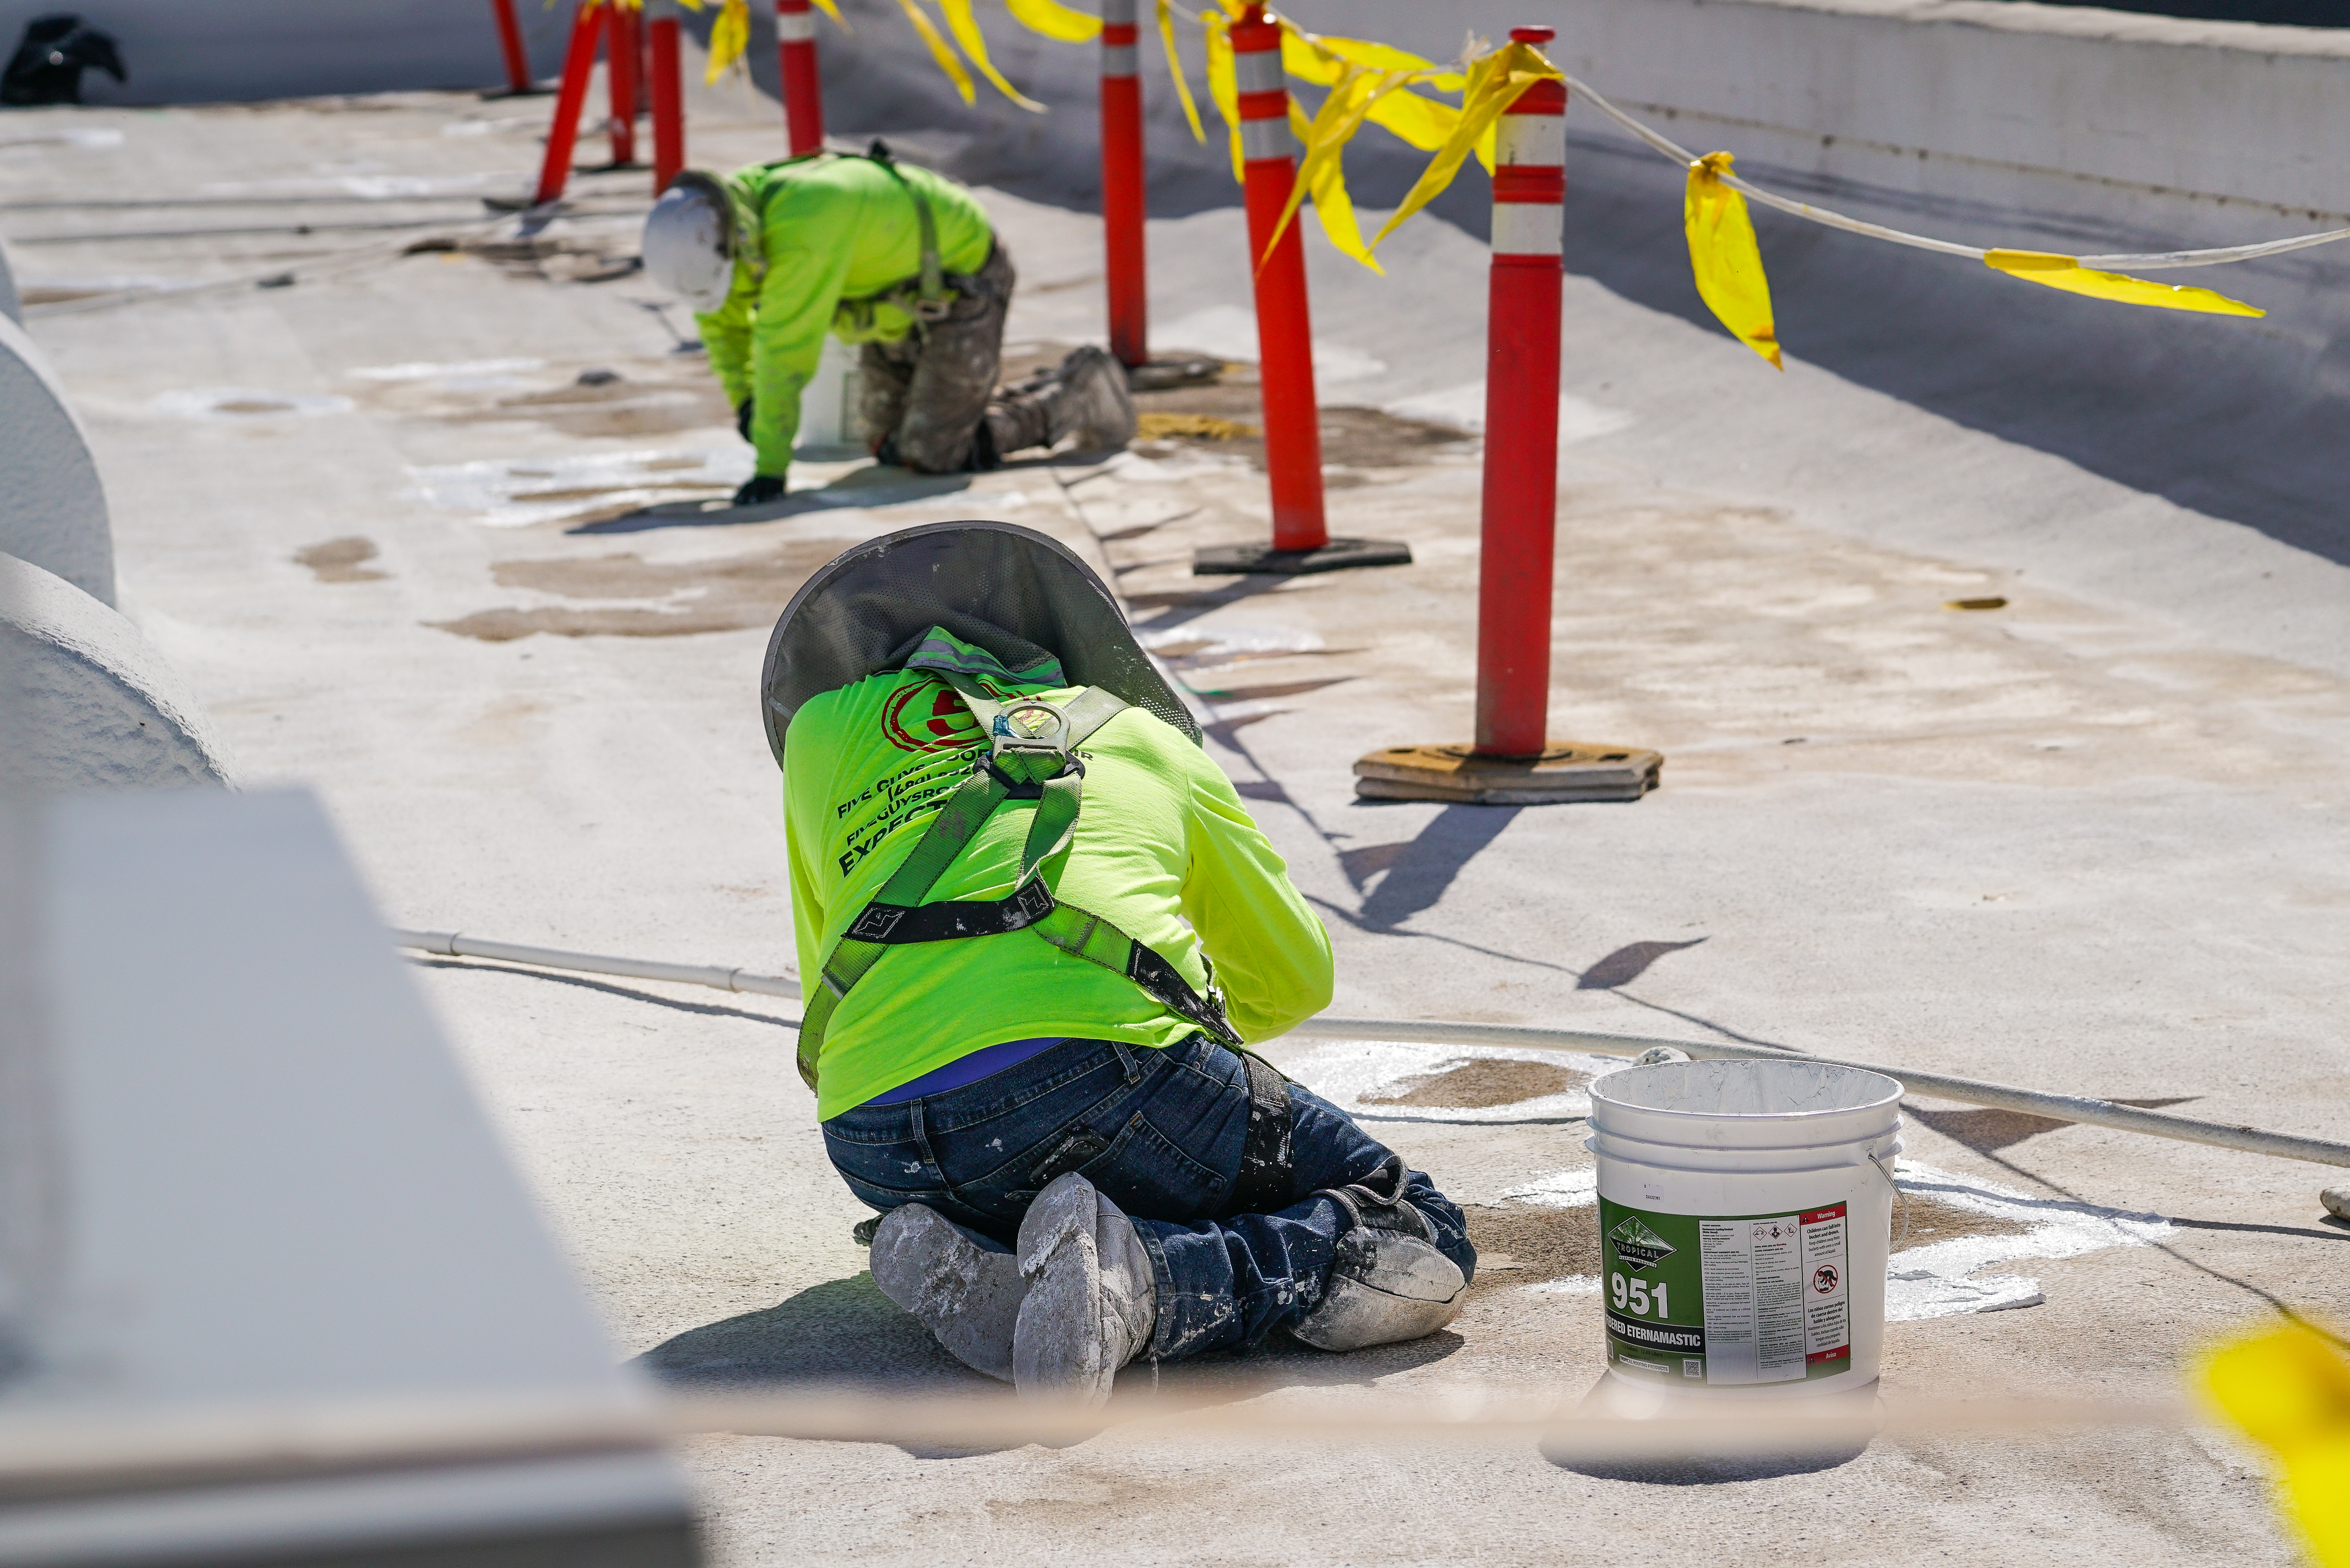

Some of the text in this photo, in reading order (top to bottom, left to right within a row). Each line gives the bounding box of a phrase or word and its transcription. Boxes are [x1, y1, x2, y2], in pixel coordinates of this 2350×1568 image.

[837, 787, 872, 819] FIVE
[839, 799, 948, 878] EXPECT
[1617, 1242, 1659, 1258] TROPICAL
[1635, 1259, 1656, 1267] PRODUCTS
[1612, 1272, 1668, 1319] 951
[1606, 1313, 1625, 1334] FIBERED
[1627, 1324, 1701, 1346] ETERNAMASTIC
[1620, 1356, 1633, 1364] TROPICAL
